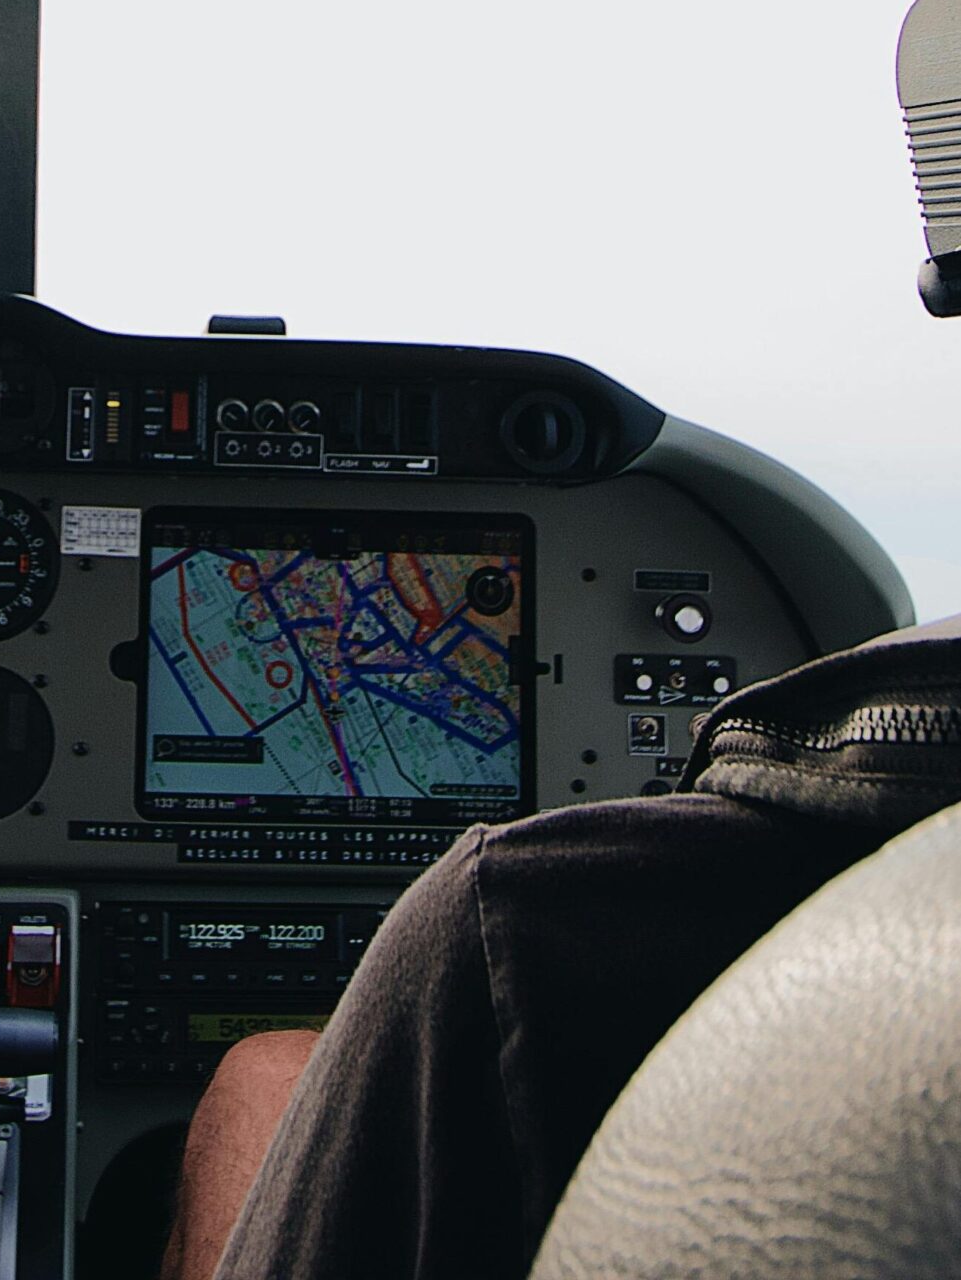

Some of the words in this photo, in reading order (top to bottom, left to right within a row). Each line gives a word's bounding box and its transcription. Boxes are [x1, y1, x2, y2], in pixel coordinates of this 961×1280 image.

[219, 799, 236, 809] km
[86, 827, 138, 838] MERCI
[189, 829, 251, 840] FERMER
[265, 831, 329, 841] TOUTES
[343, 832, 374, 842] LES
[185, 849, 260, 859] REGLAGE
